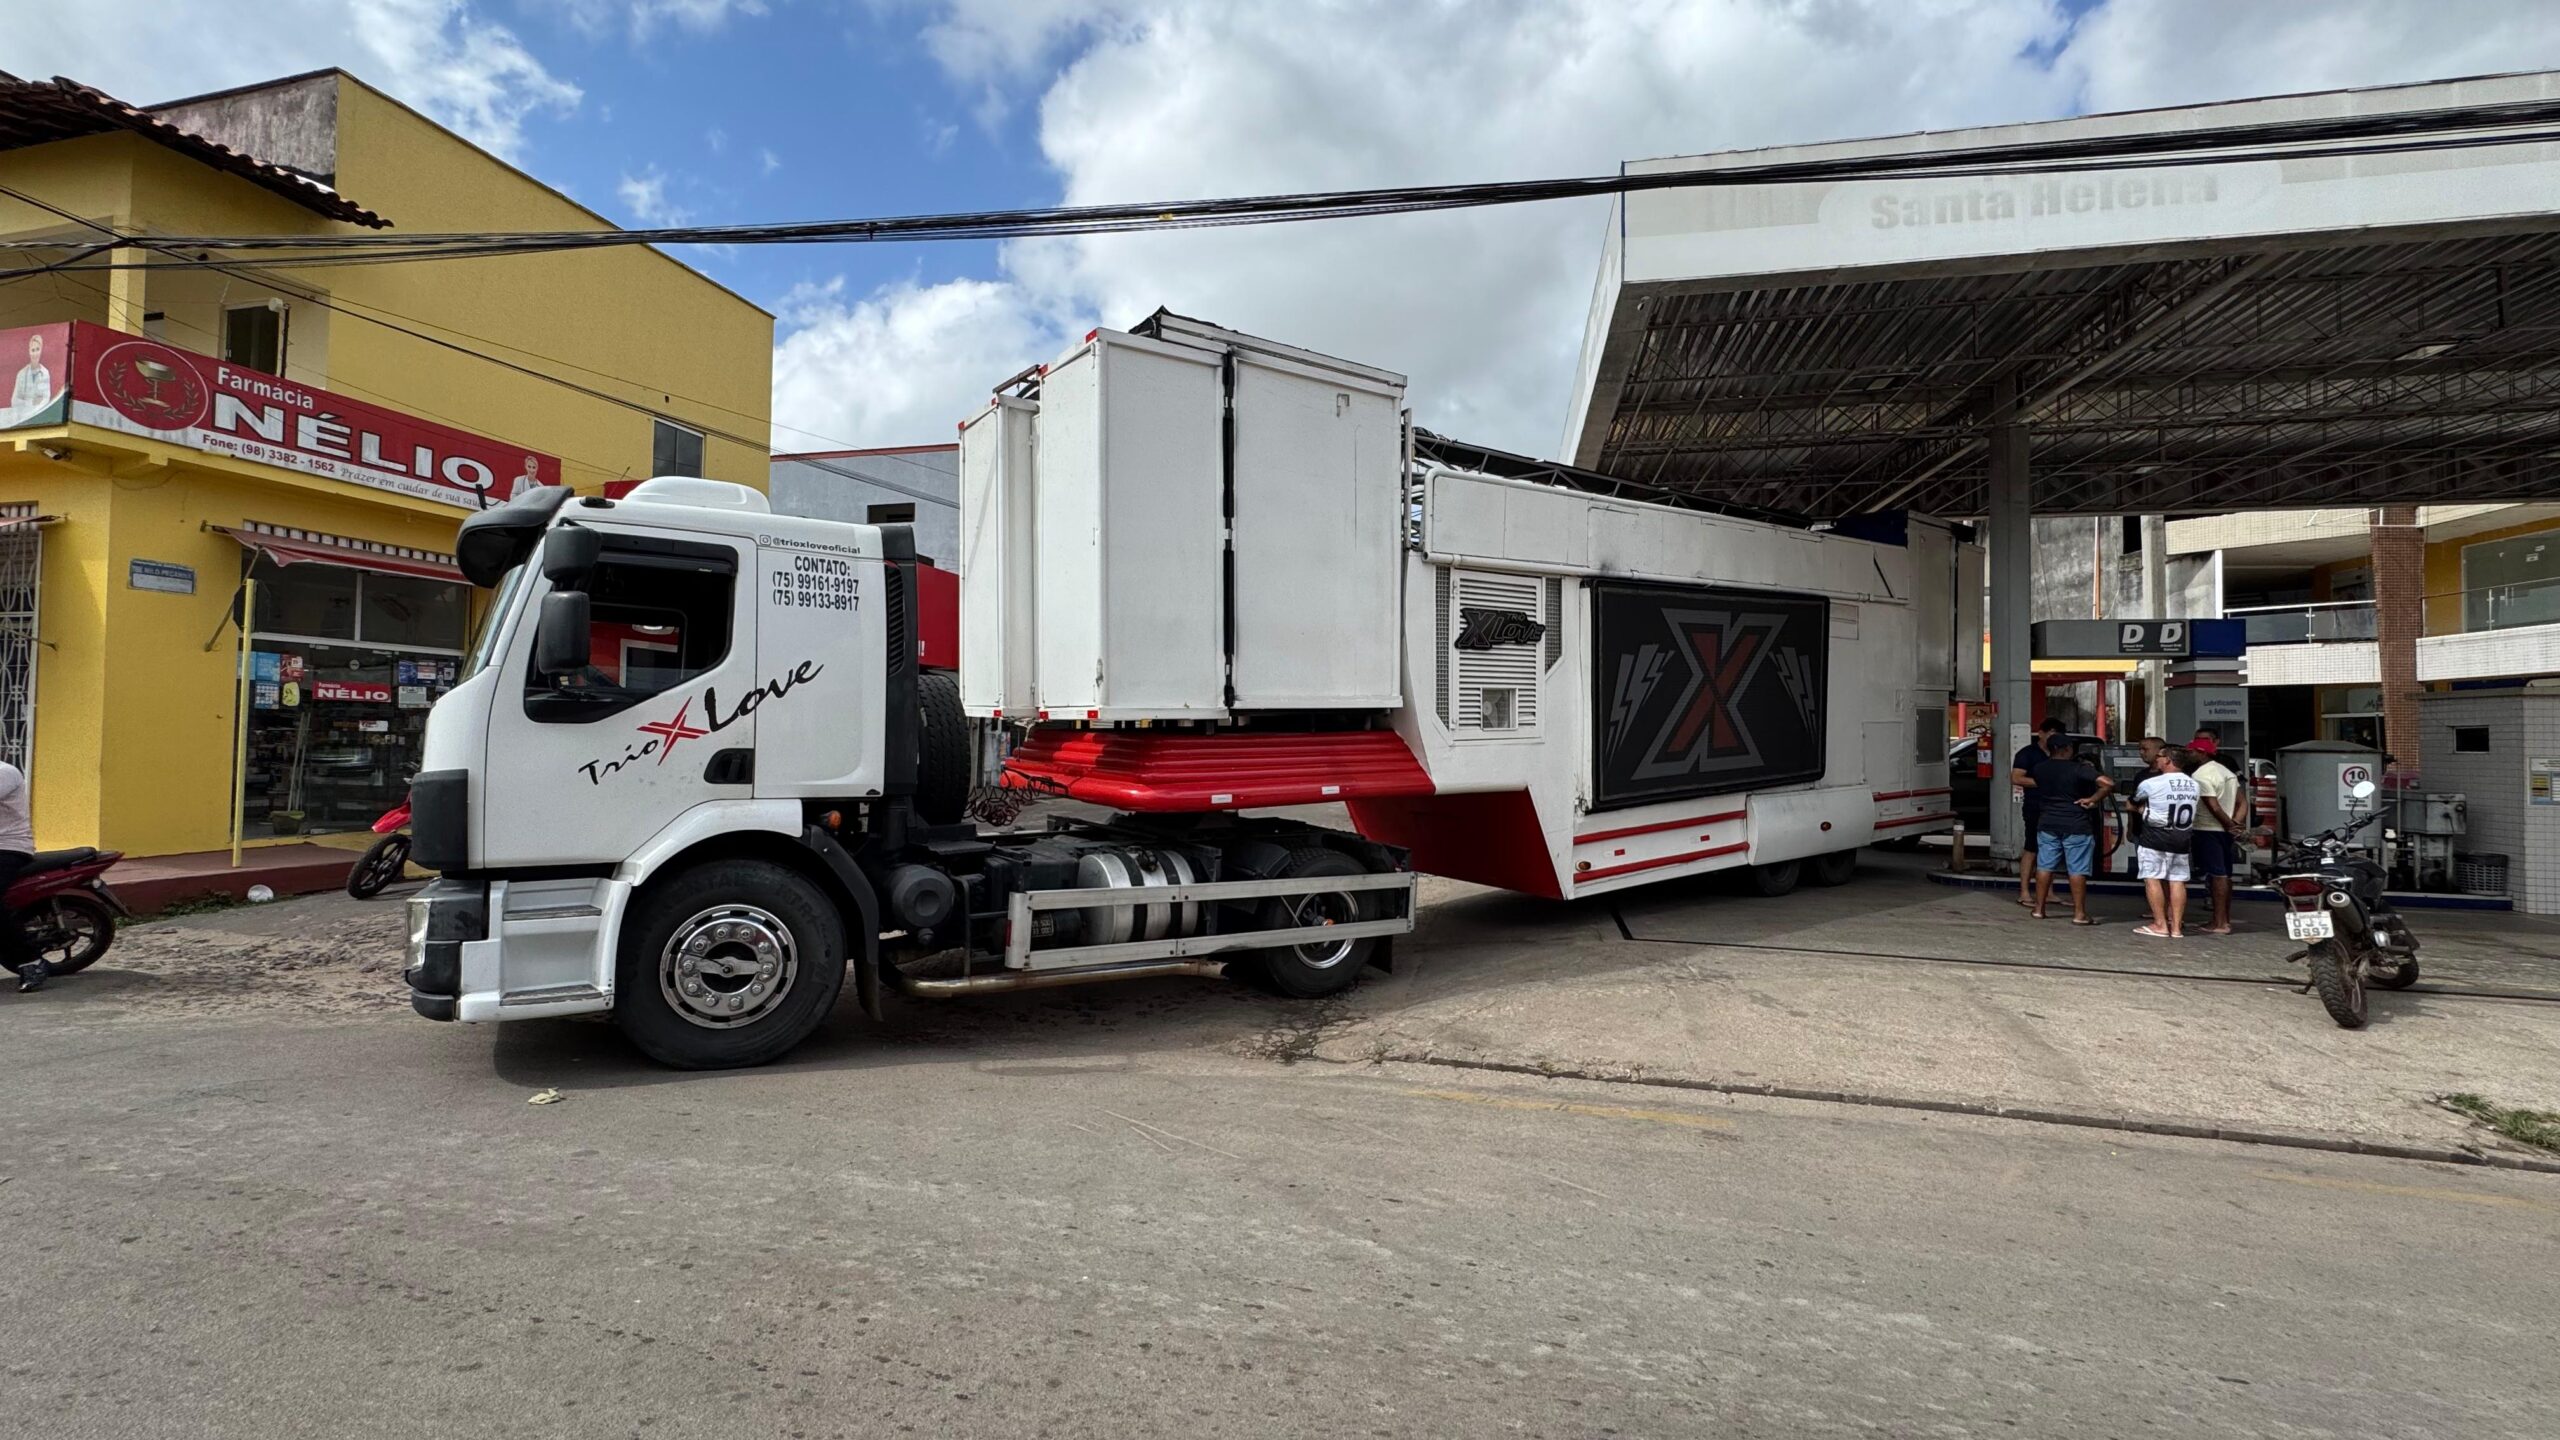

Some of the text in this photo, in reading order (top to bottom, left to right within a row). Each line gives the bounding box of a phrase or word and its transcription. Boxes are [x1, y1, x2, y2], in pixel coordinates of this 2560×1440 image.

[1871, 187, 2015, 229] Santa
[218, 366, 314, 409] Farmácia
[213, 391, 496, 491] NÉLIO
[202, 433, 238, 451] Fone:
[241, 443, 265, 458] (98)
[269, 449, 298, 464] 3382
[308, 458, 335, 473] 1562
[341, 467, 376, 484] Prazer
[379, 478, 395, 489] em
[397, 482, 429, 496] cuidar
[431, 487, 443, 499] de
[445, 494, 460, 504] sua
[773, 538, 861, 554] @trioxloveoficial
[794, 555, 851, 576] CONTATO:
[772, 571, 859, 595] (75) 99161-9197
[772, 589, 860, 611] (75) 99133-8917
[2121, 624, 2145, 644] D
[317, 687, 389, 701] NÉLIO
[2169, 780, 2195, 788] EZZE
[2349, 770, 2366, 780] 10
[2165, 803, 2193, 831] 10
